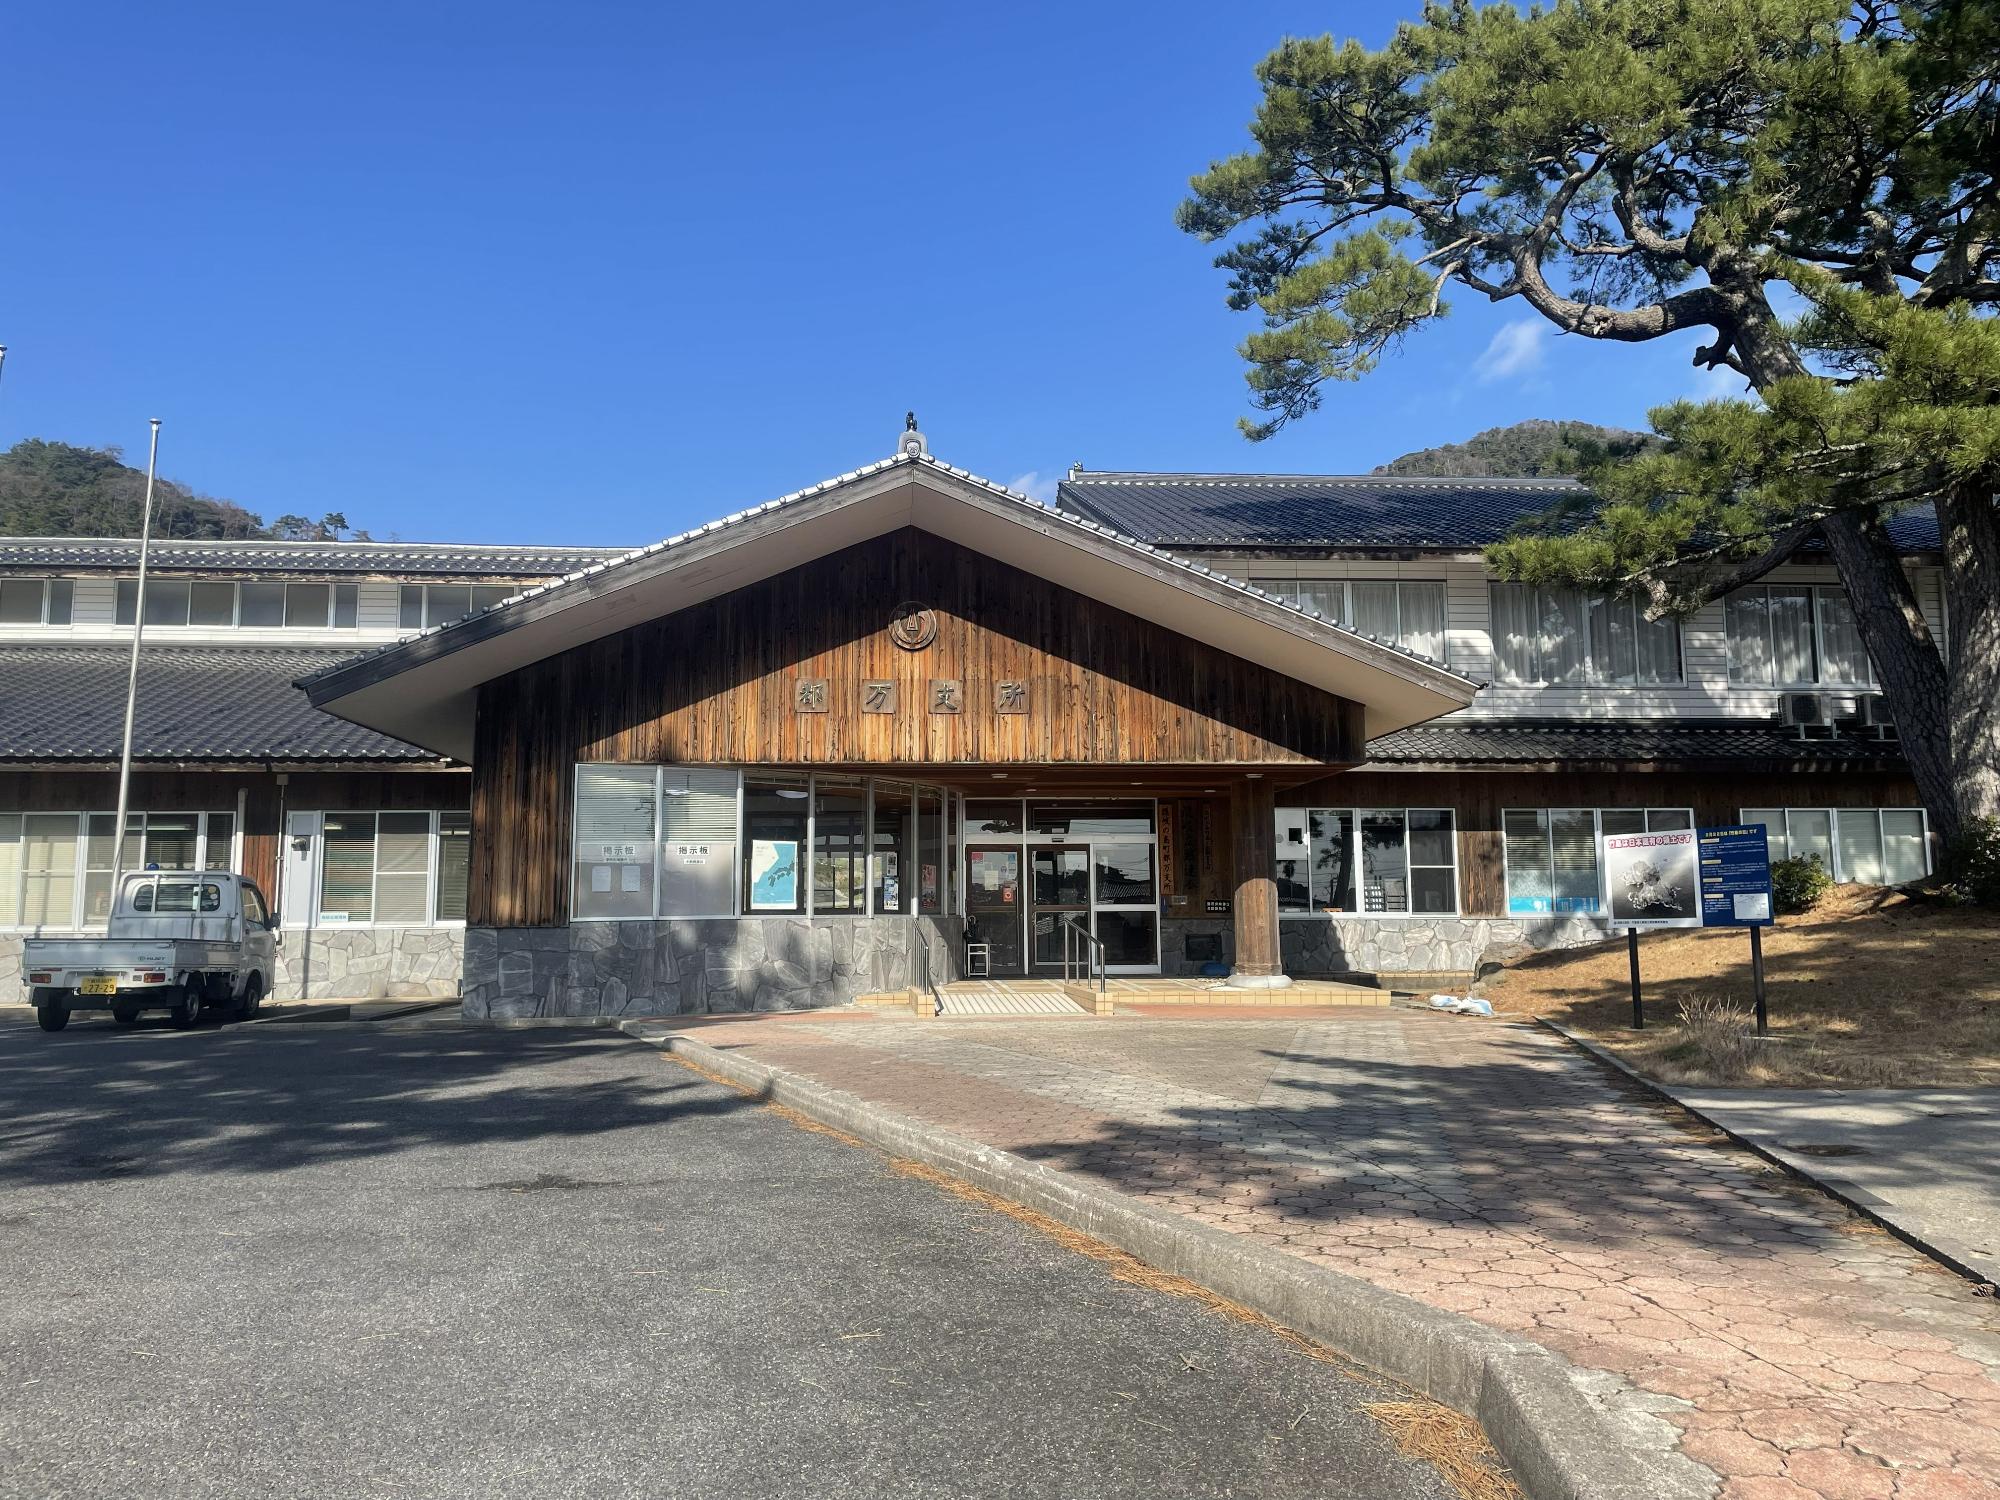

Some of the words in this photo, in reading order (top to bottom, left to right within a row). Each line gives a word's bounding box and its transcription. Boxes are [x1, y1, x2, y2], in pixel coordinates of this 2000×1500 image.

[799, 683, 1026, 710] 都万支所
[1608, 834, 1693, 849] 竹島は日本固有の領土です
[603, 846, 634, 855] 掲示板
[678, 846, 709, 855] 掲示板
[88, 984, 114, 992] 27-29
